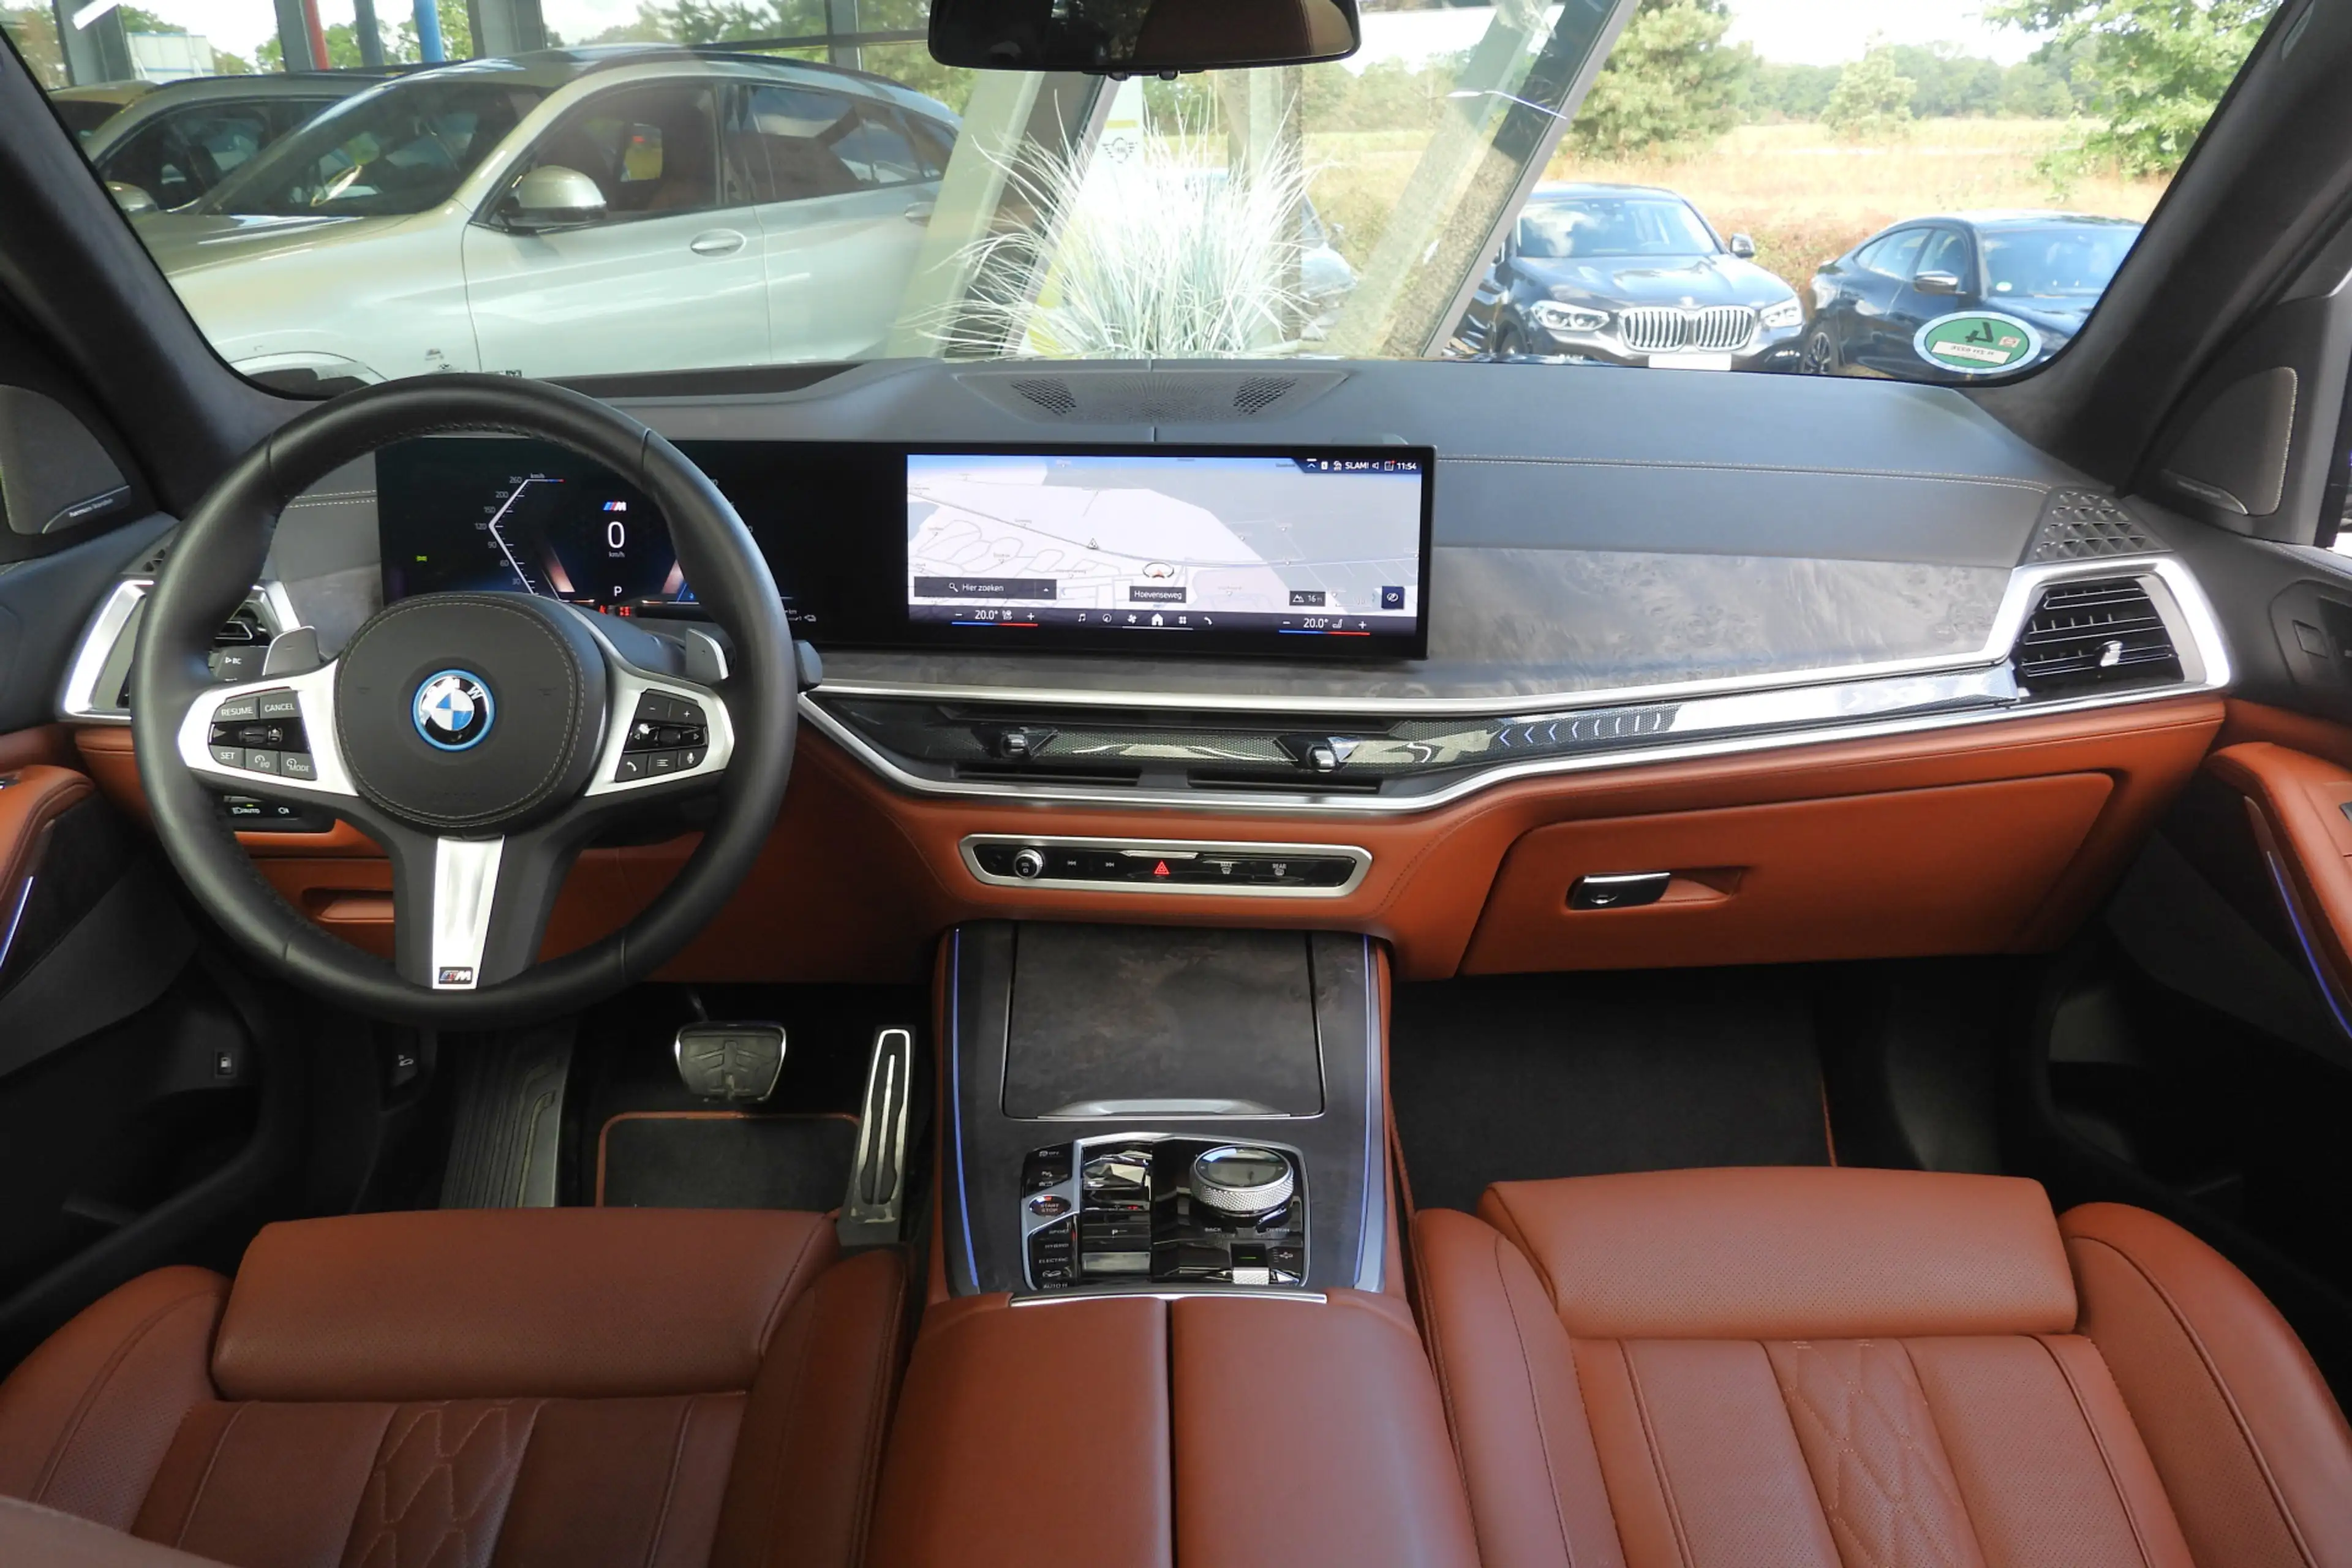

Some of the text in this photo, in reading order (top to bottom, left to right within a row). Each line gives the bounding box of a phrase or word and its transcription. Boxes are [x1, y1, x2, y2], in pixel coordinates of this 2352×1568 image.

[607, 521, 625, 548] 0
[614, 586, 622, 597] P
[1134, 590, 1182, 600] Hoevenseweg
[221, 706, 254, 716] RESUME
[264, 703, 295, 712] CANCEL
[220, 752, 236, 760] SET
